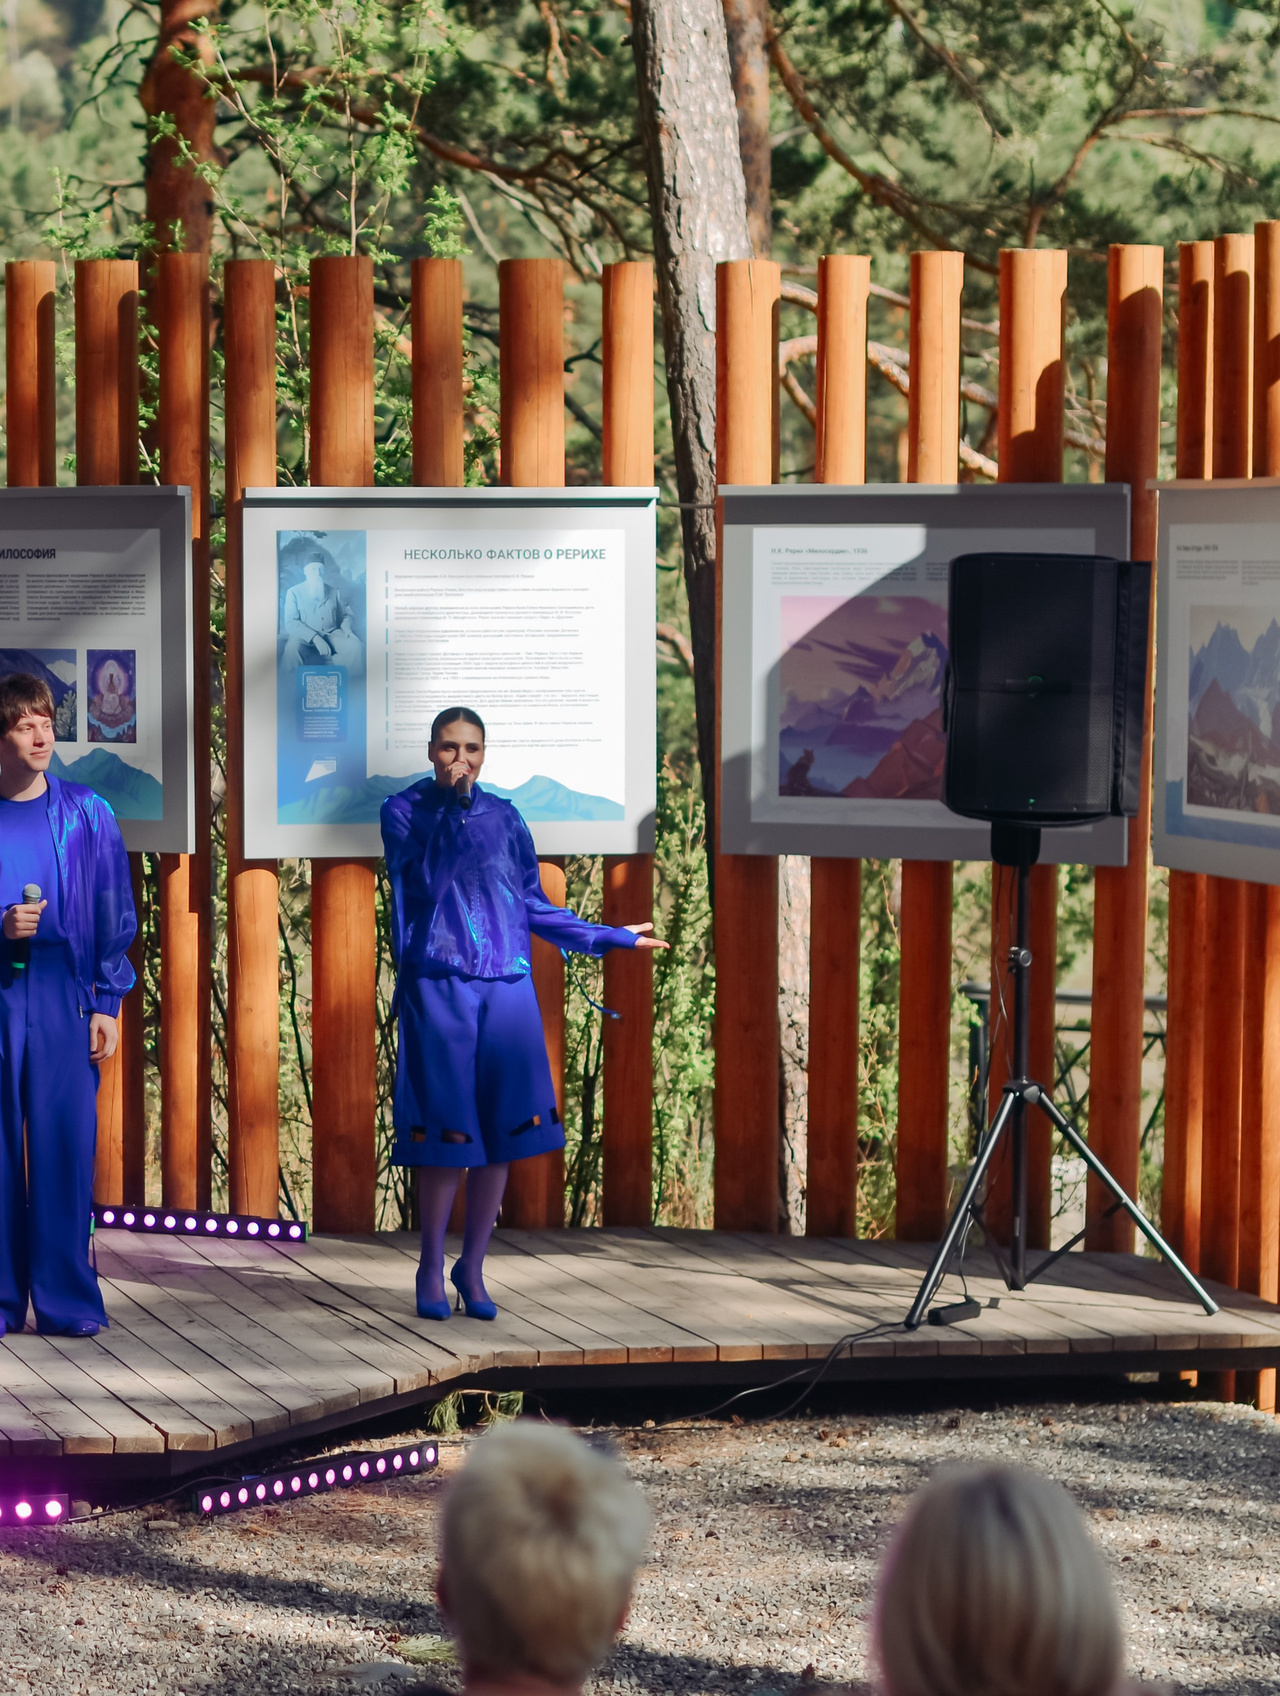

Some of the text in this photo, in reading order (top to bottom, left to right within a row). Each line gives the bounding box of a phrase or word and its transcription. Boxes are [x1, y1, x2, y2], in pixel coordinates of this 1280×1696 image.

[403, 548, 607, 560] НЕСКОЛЬКО ФАКТОВ О РЕРИХЕ
